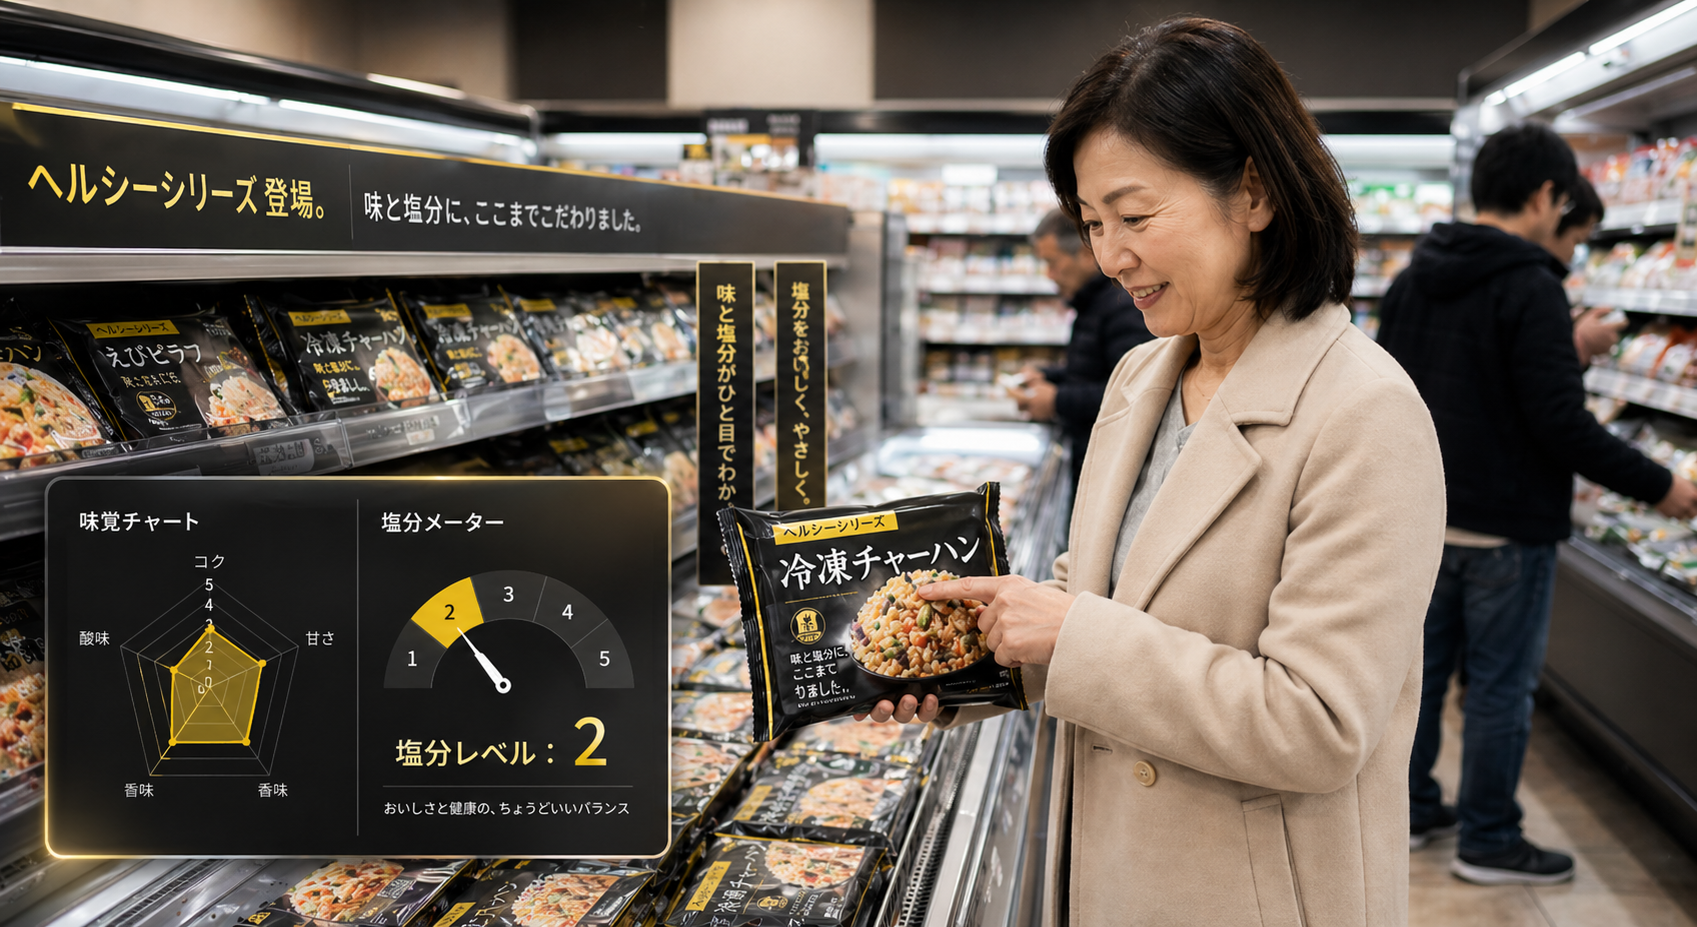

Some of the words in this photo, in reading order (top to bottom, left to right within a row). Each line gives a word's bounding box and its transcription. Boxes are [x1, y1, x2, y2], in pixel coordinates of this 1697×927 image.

[364, 190, 642, 233] 味と塩分に、ここまでこだわりました。
[783, 515, 886, 537] ヘルシーシリーズ
[779, 536, 980, 591] 冷凍チャーハン
